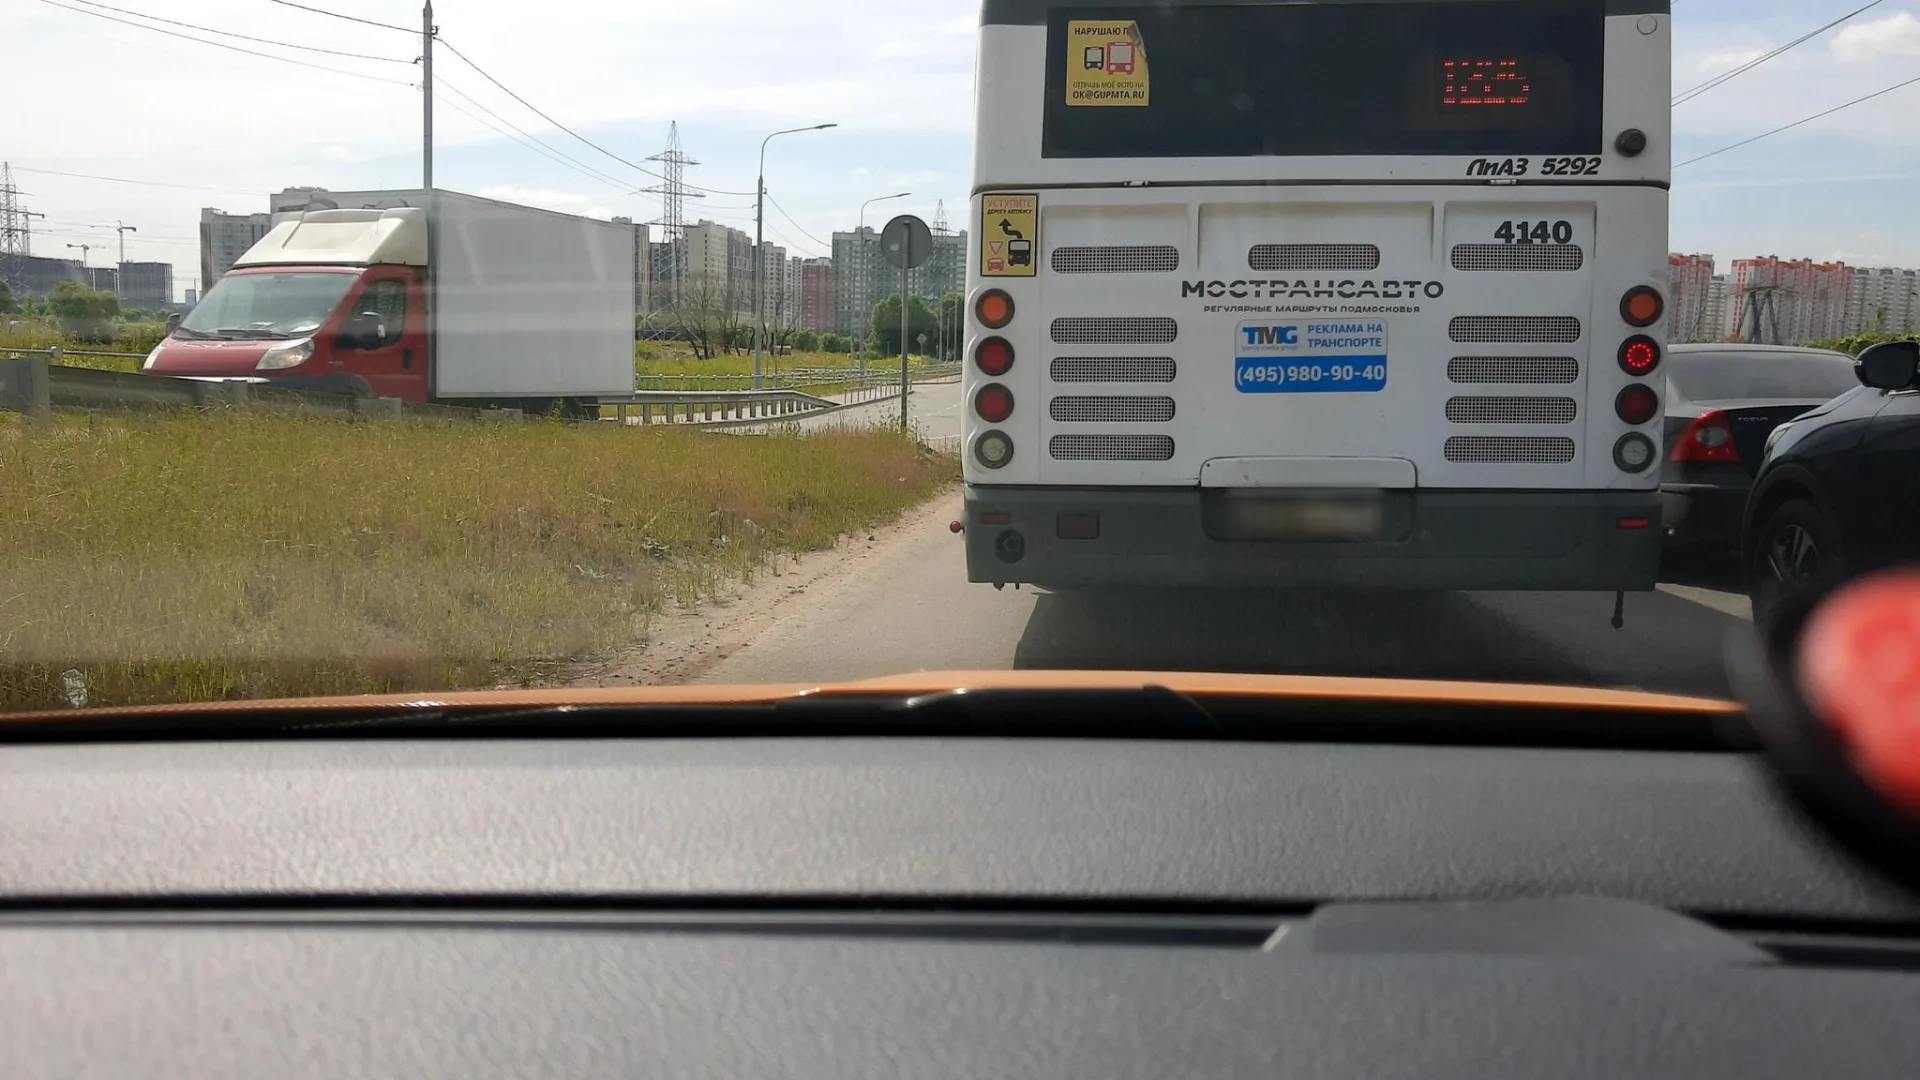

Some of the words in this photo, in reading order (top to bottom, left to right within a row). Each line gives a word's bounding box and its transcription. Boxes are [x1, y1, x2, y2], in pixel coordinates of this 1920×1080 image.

[1074, 27, 1121, 36] НАРУШАЮ
[1116, 81, 1134, 89] ФОТО
[1135, 81, 1145, 89] НА
[1072, 90, 1145, 99] OK@GUPMTA.RU
[1540, 157, 1602, 176] 5292
[987, 198, 1033, 208] УСТУПИТЕ
[1494, 220, 1573, 244] 4140
[1181, 279, 1444, 299] МОСТРАНСАВТО
[1203, 305, 1273, 313] РЕГУЛЯРНЫЕ
[1275, 305, 1338, 313] МАРШРУТЫ
[1340, 305, 1420, 313] ПОДМОСКОВЬЯ
[1307, 323, 1364, 334] РЕКЛАМА
[1366, 322, 1383, 333] НА
[1242, 325, 1298, 345] TMG
[1307, 337, 1382, 348] ТРАНСПОРТЕ
[1237, 365, 1285, 386] (495)
[1287, 365, 1385, 382] 980-90-40
